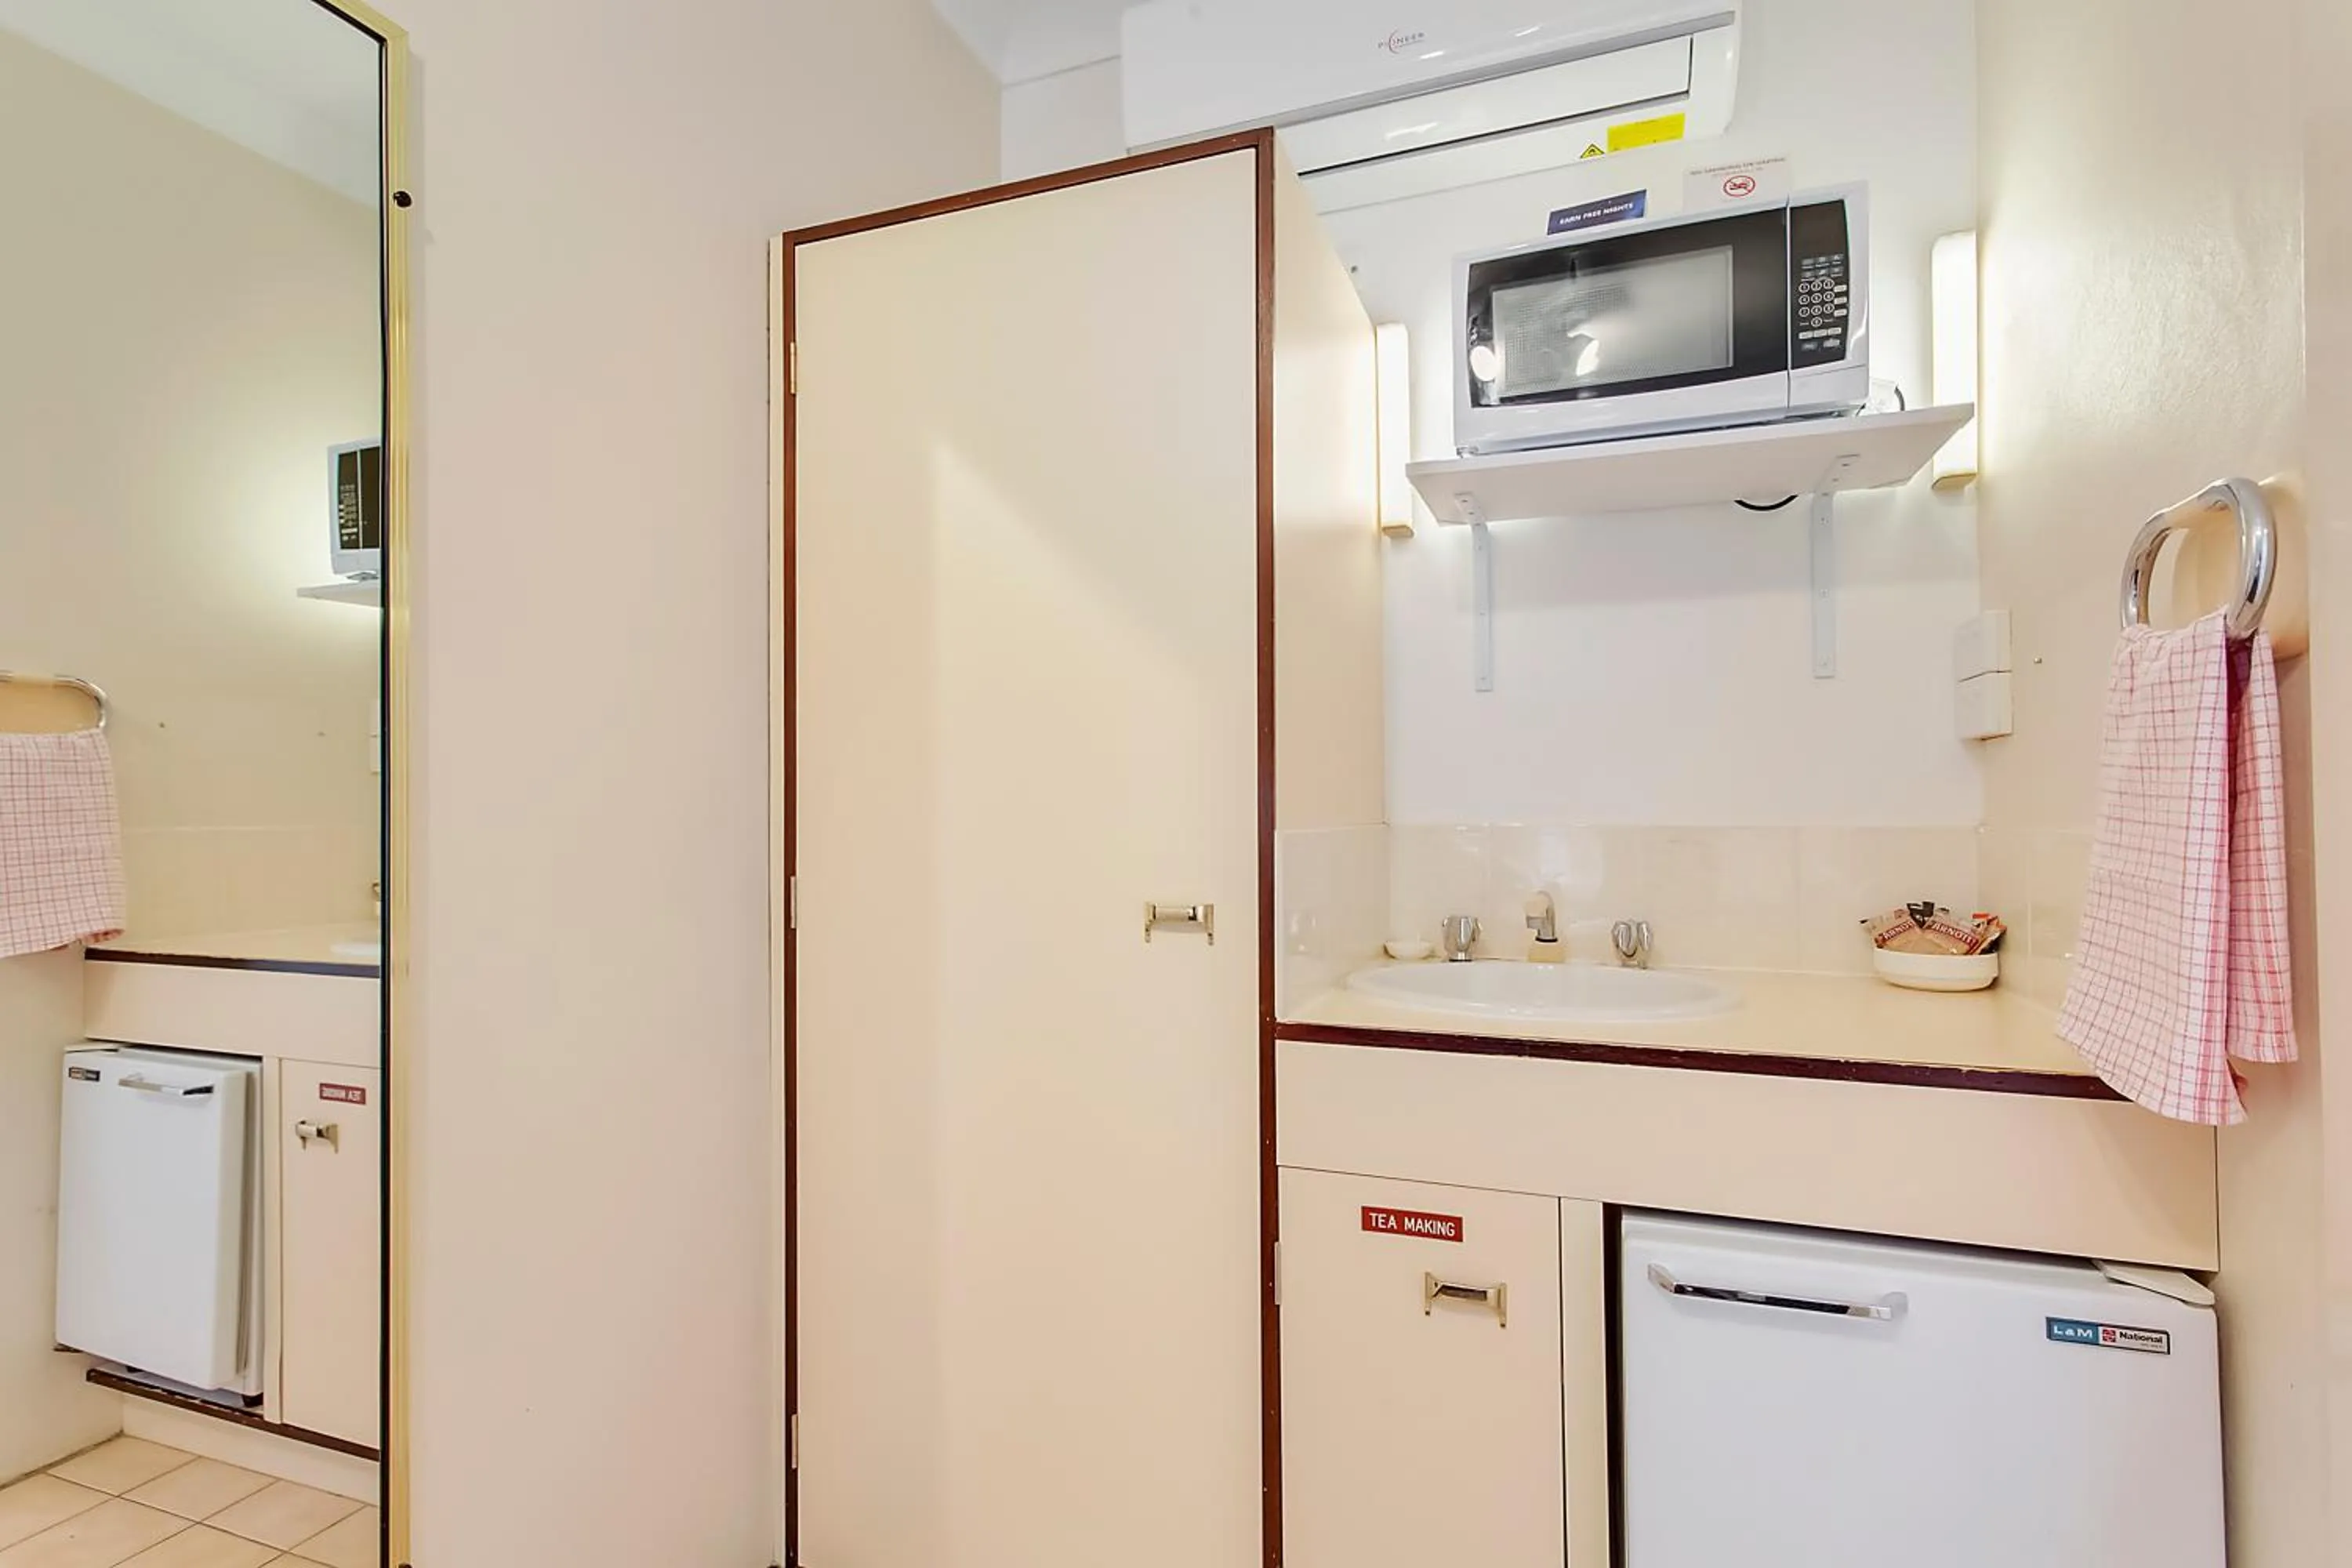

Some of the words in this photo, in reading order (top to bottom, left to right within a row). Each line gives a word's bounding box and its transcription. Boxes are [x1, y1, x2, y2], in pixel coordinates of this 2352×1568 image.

[1369, 1213, 1397, 1229] TEA
[1404, 1216, 1455, 1236] MAKING
[2119, 1331, 2162, 1344] National
